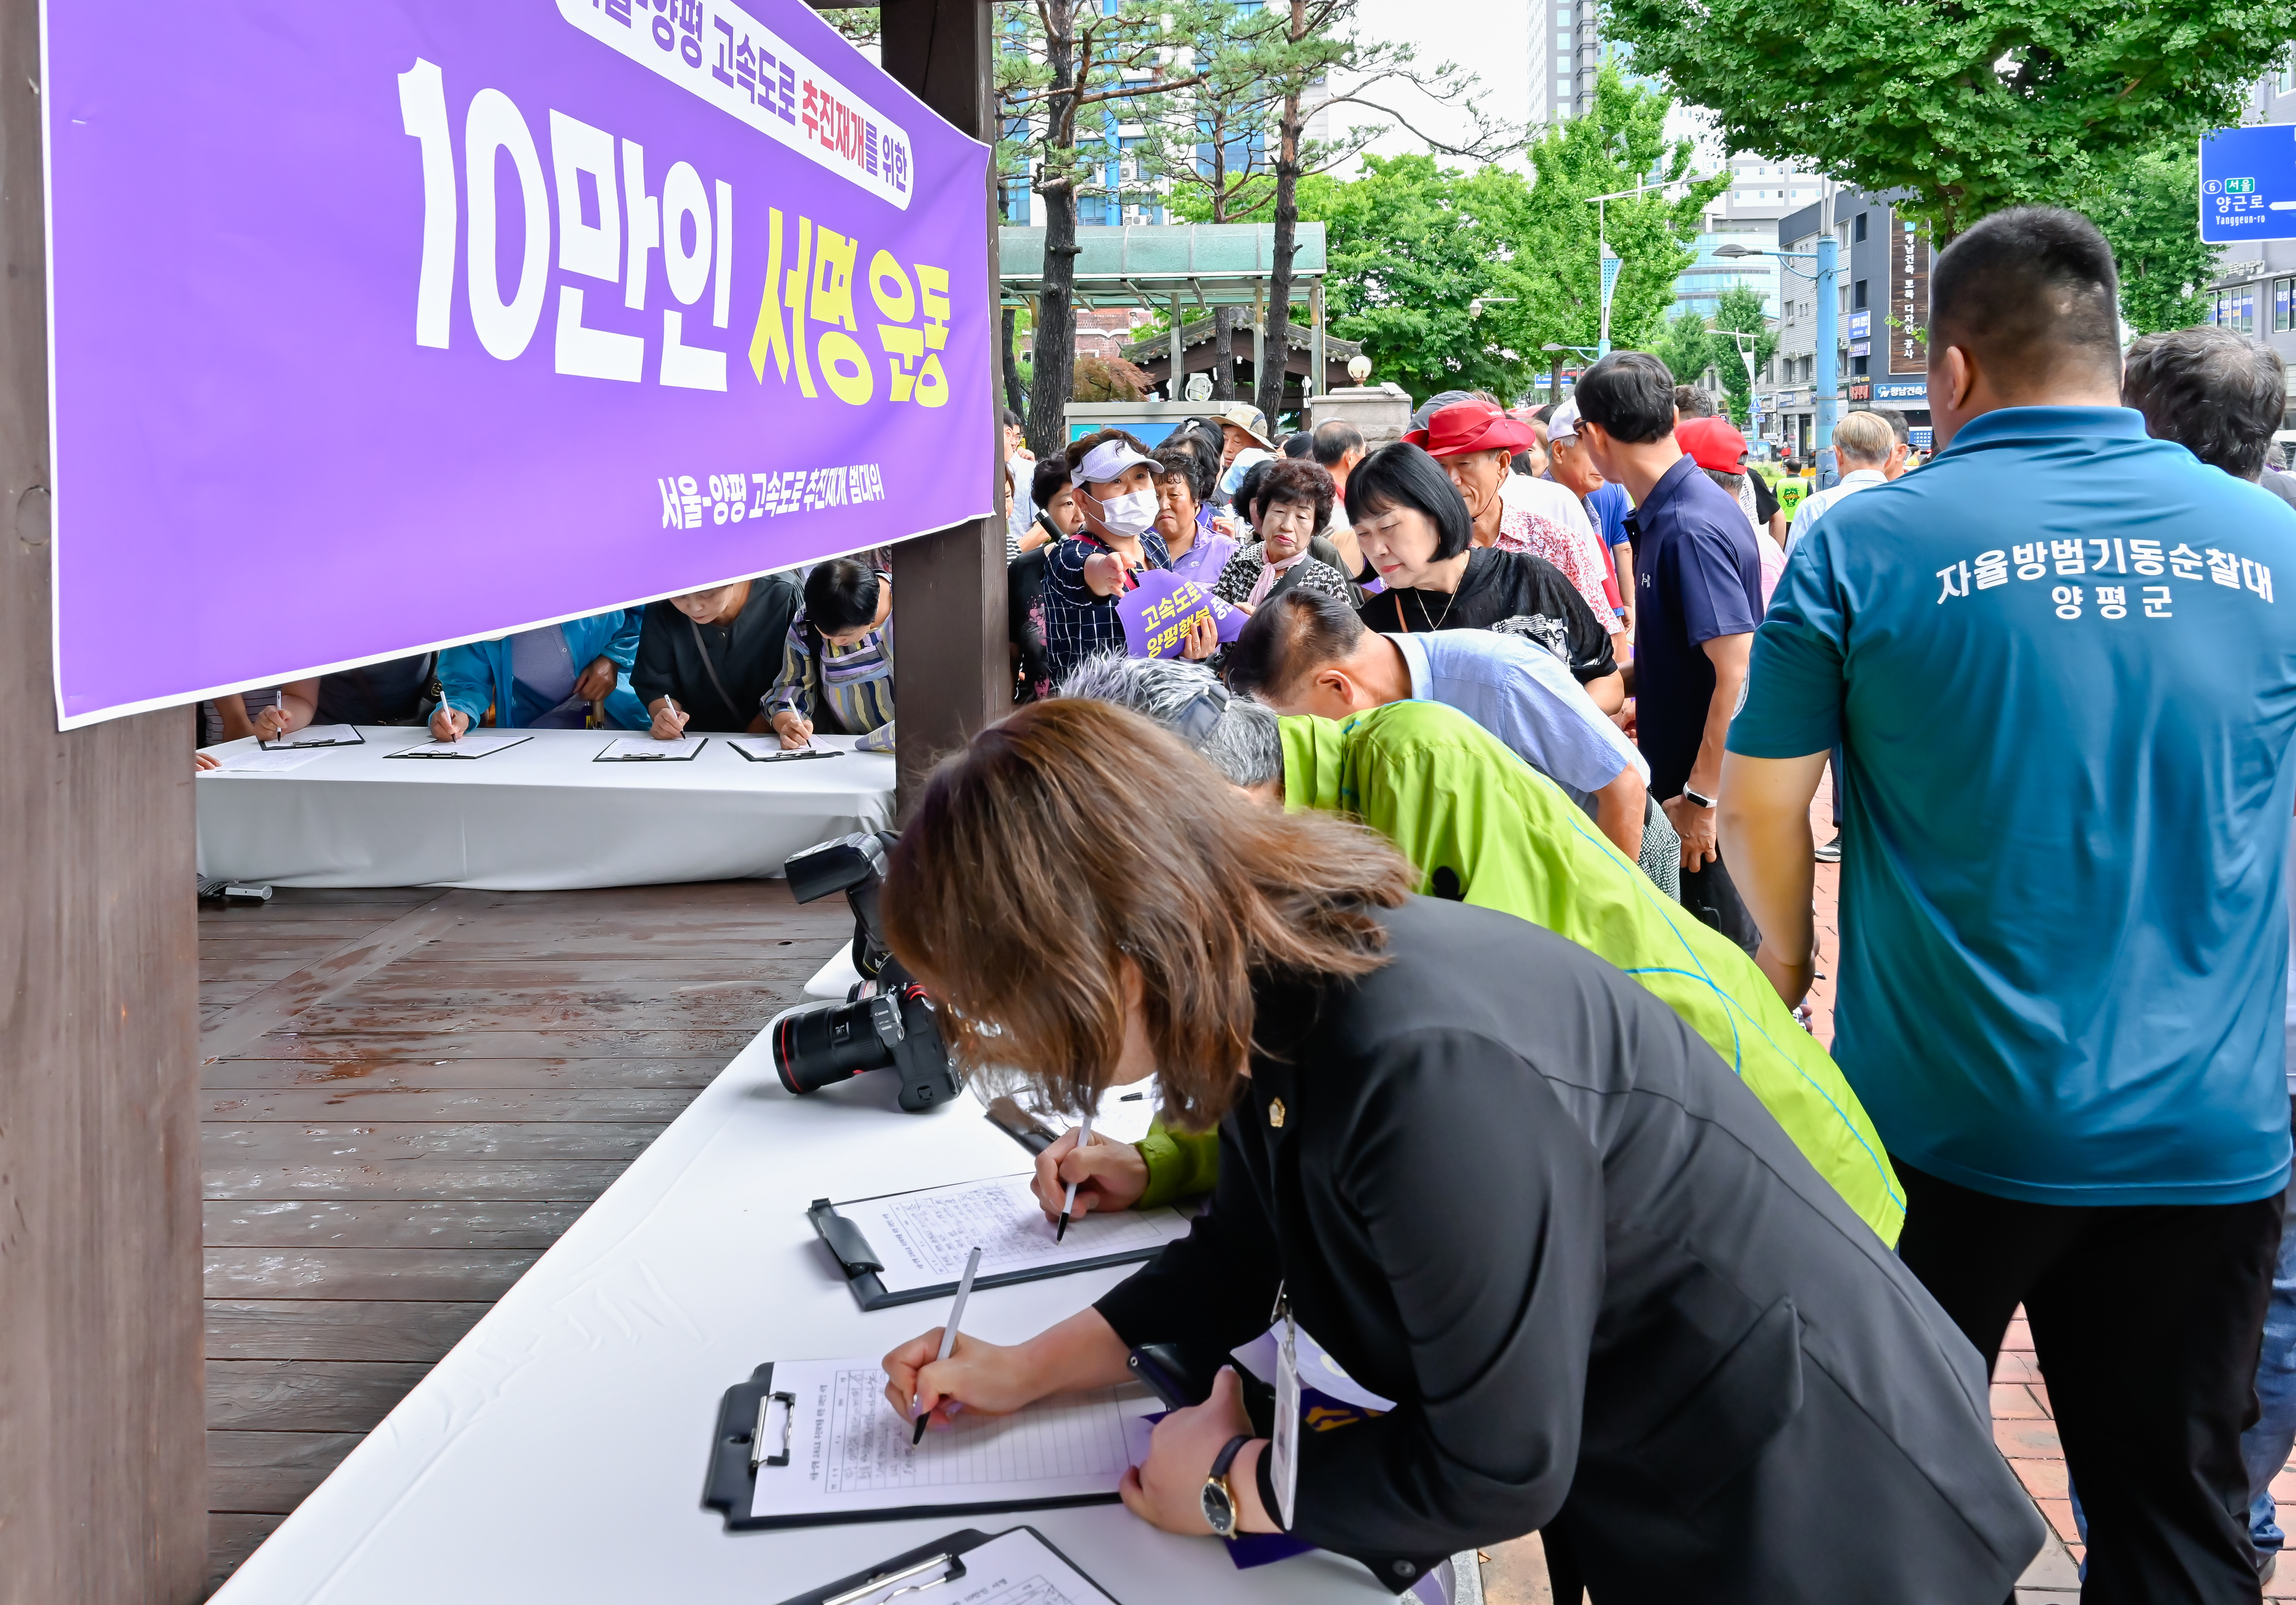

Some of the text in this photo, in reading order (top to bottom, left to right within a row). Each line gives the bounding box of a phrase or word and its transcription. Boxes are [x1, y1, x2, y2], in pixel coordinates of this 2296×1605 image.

[712, 14, 795, 126] 고속도로
[802, 79, 878, 177] 추진재개를
[883, 135, 907, 193] 위한
[2209, 179, 2251, 192] 6 서울
[2216, 195, 2264, 213] 양근로
[397, 57, 950, 408] 10만인 서명 운동
[2216, 215, 2265, 227] Yanggeun-ro
[1904, 234, 1915, 359] 청남건축 토목 디자인 공사
[658, 463, 885, 529] 서울-양평 고속도로 추진재개 범대위
[1936, 538, 2274, 605] 자율방범기동순찰대
[1141, 581, 1202, 633] 고속도로
